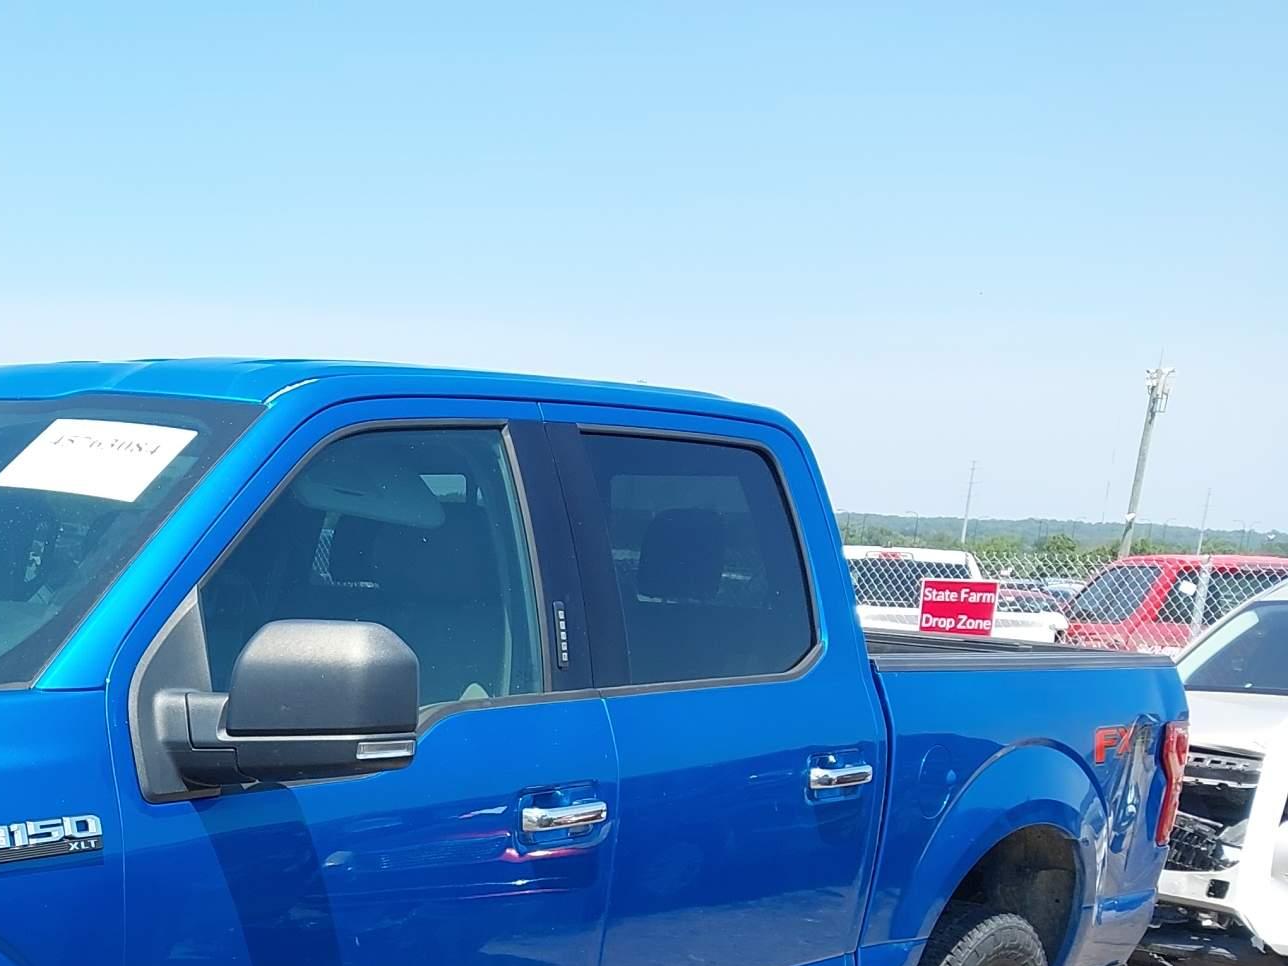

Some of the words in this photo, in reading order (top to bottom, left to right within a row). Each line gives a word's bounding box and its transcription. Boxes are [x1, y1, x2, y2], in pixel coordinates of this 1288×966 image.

[923, 587, 958, 602] State
[960, 588, 996, 604] Farm
[921, 613, 955, 631] Drop
[956, 614, 992, 630] Zone
[68, 839, 99, 851] XLT
